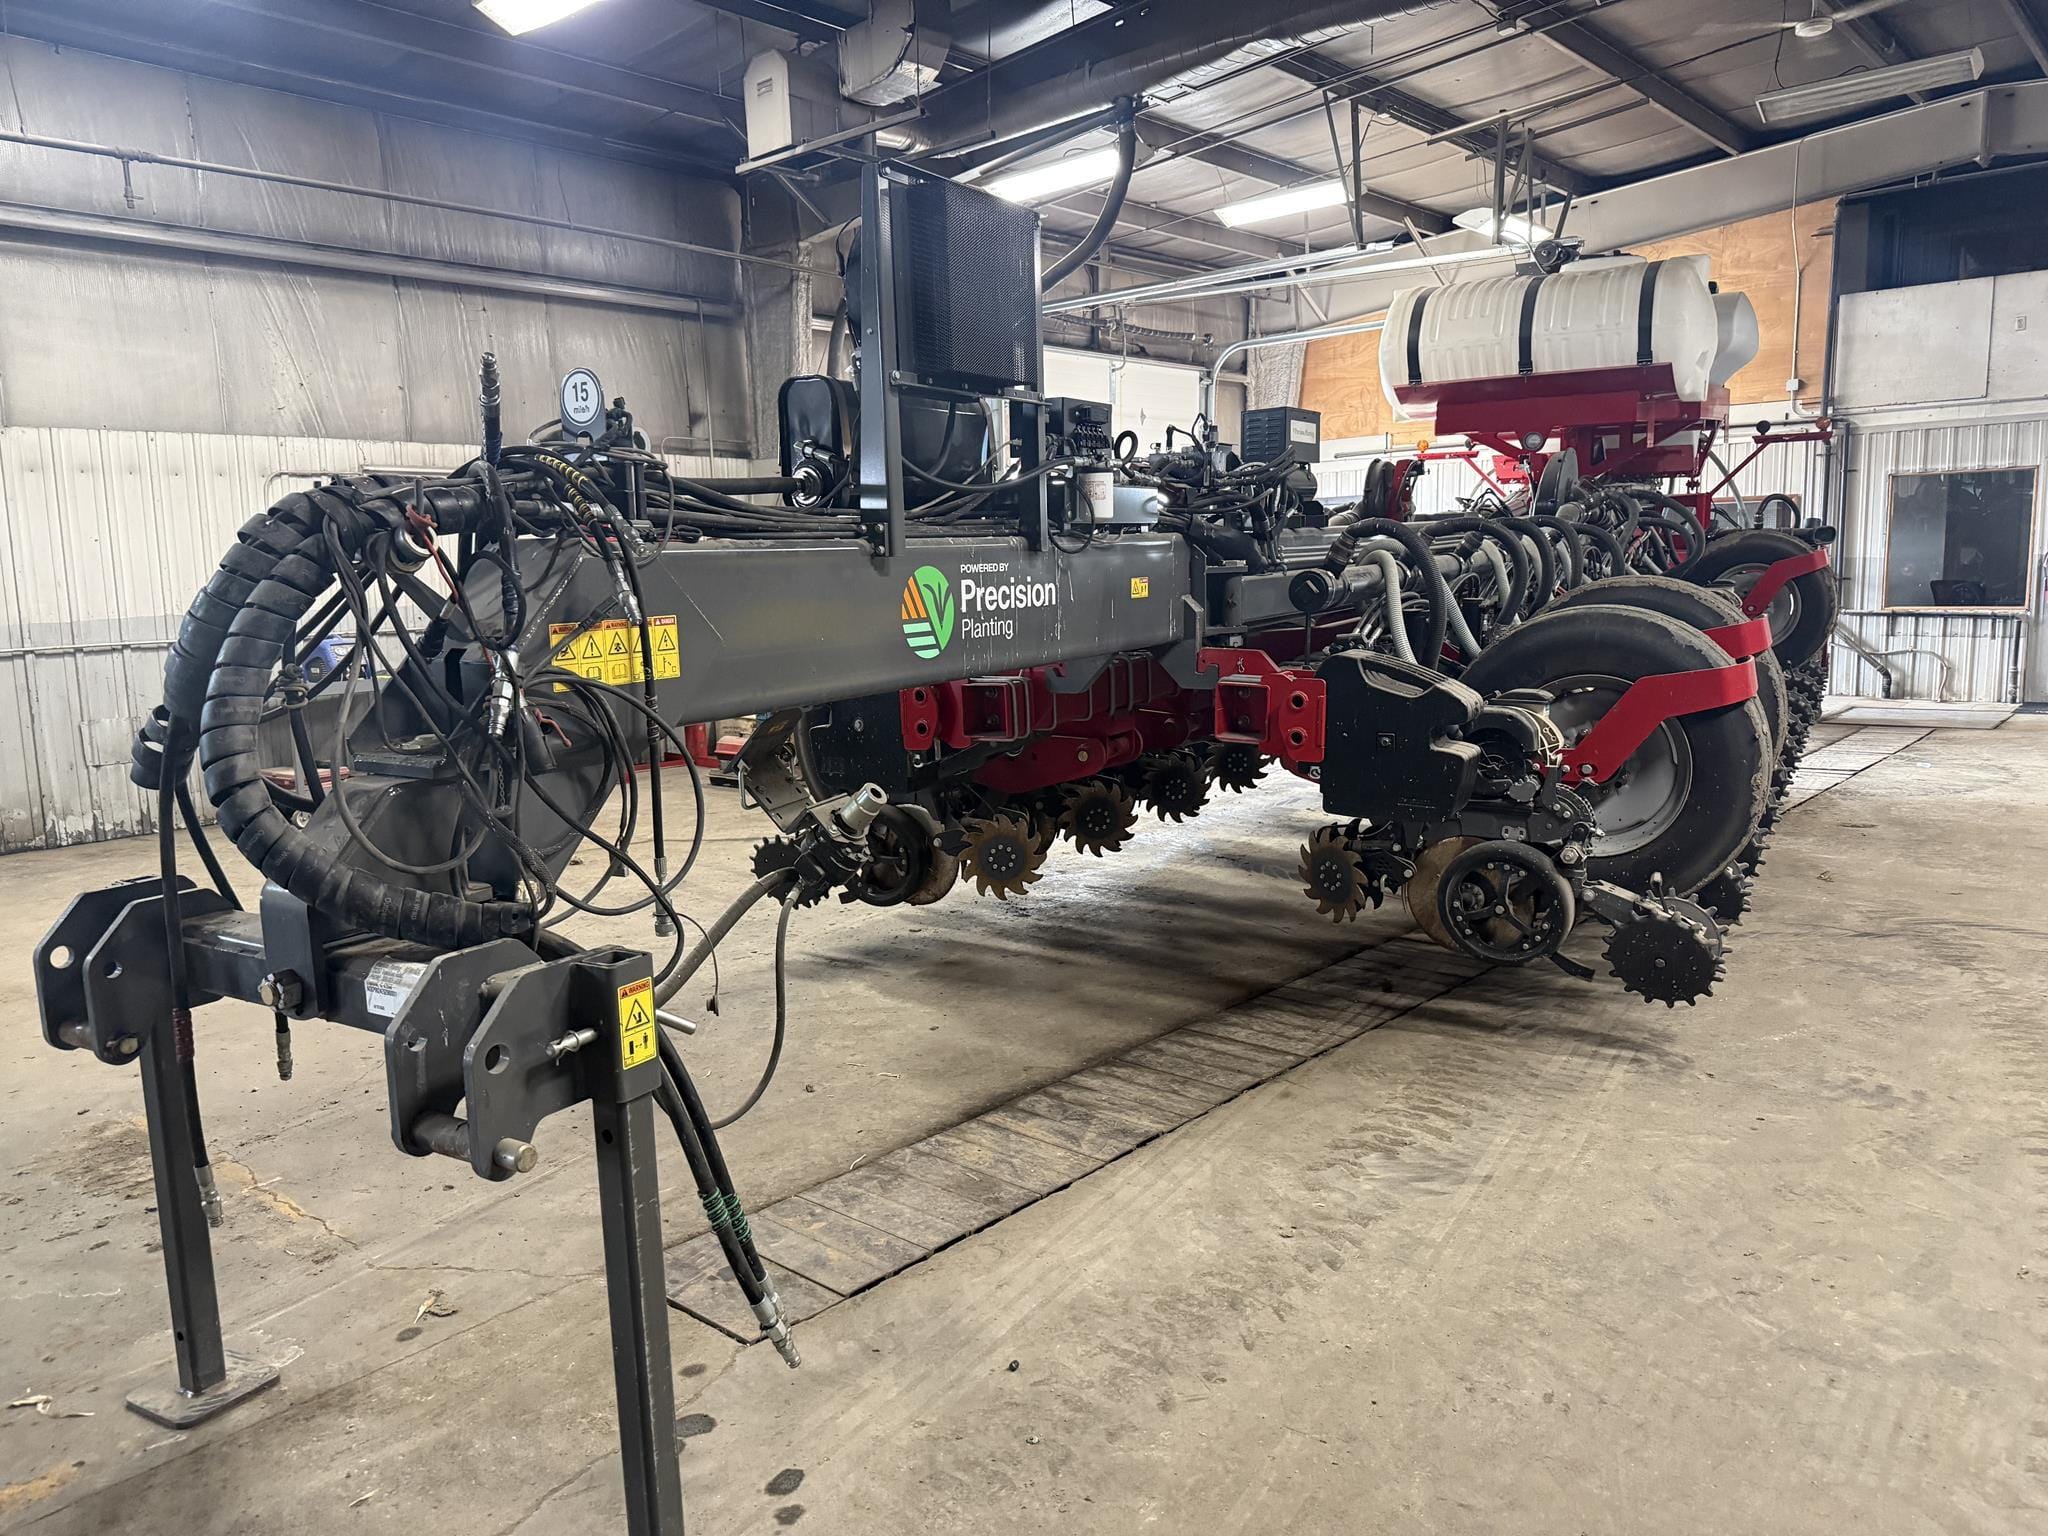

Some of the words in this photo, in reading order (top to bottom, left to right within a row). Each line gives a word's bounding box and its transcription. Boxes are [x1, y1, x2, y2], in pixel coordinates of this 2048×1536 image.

[572, 381, 589, 402] 15
[960, 563, 999, 574] POWERED
[999, 562, 1009, 572] BY
[960, 576, 1056, 613] Precision
[961, 616, 1014, 640] Planting
